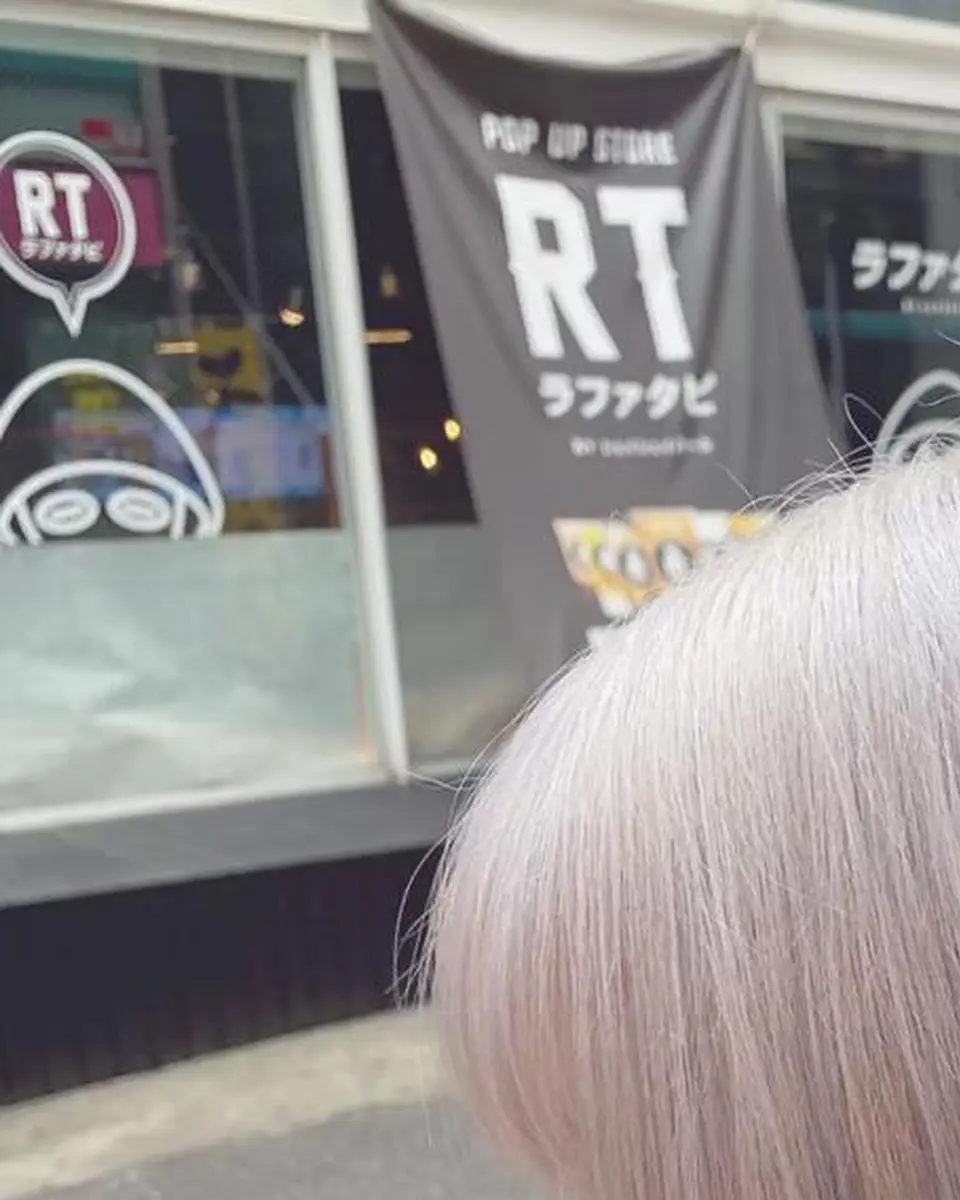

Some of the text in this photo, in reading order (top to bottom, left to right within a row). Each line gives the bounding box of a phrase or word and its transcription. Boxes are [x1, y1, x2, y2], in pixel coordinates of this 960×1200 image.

[480, 112, 678, 165] POP UP STORE
[13, 169, 92, 239] RT
[495, 173, 693, 362] RT
